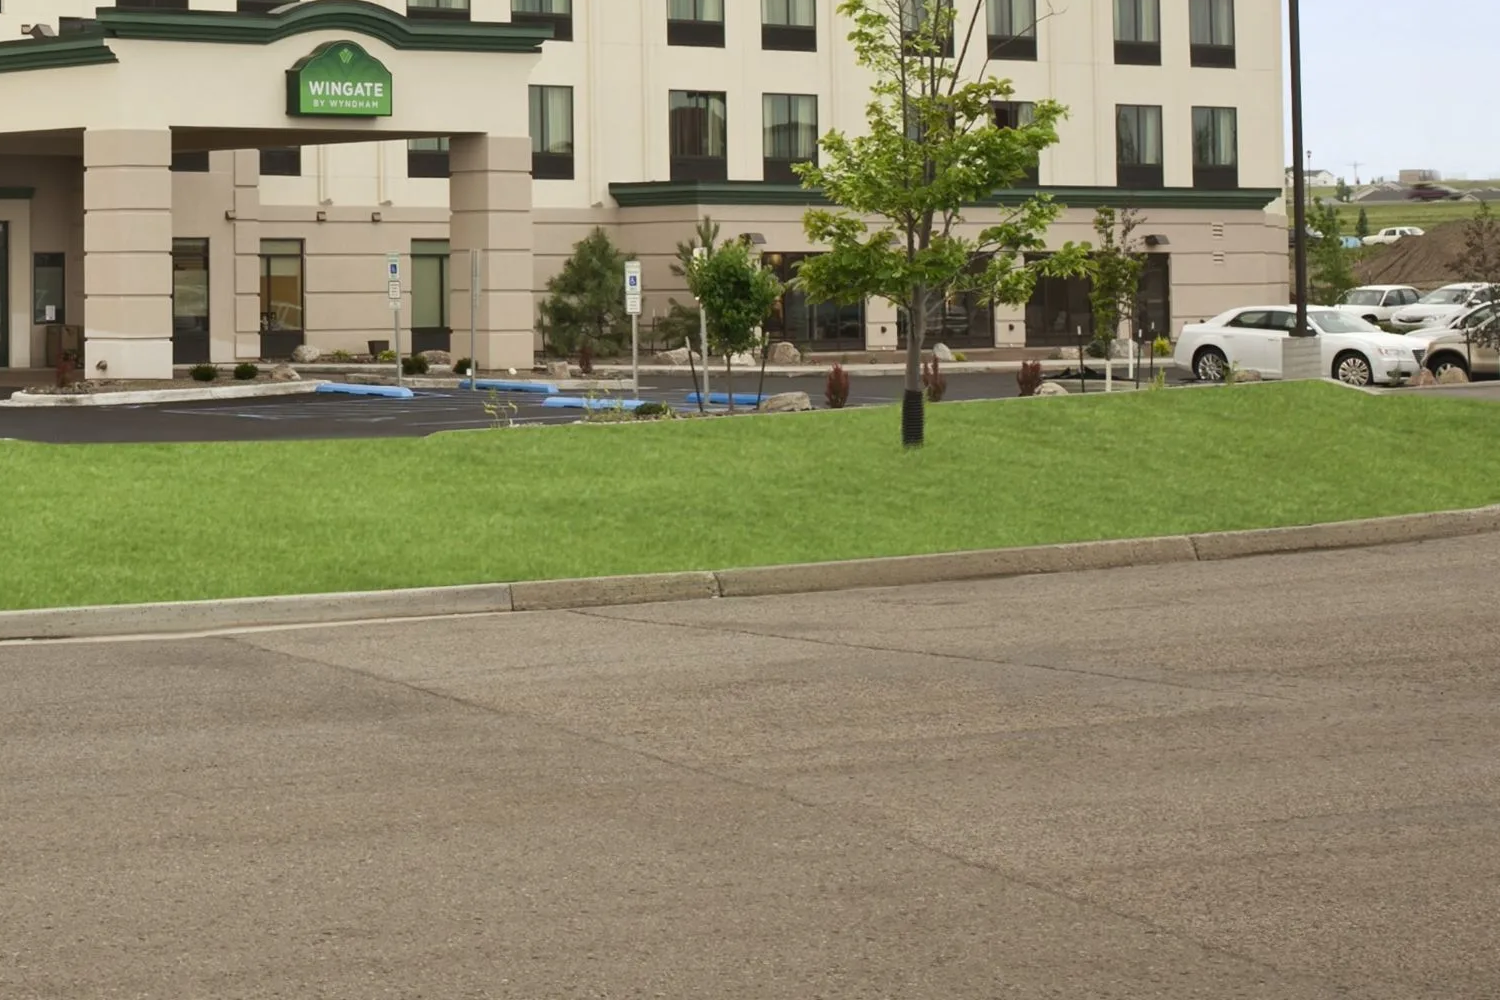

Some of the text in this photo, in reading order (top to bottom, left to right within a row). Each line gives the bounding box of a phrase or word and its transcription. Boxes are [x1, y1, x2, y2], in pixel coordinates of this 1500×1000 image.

[309, 81, 383, 97] WINGATE
[313, 99, 379, 109] BY WYNDHAM
